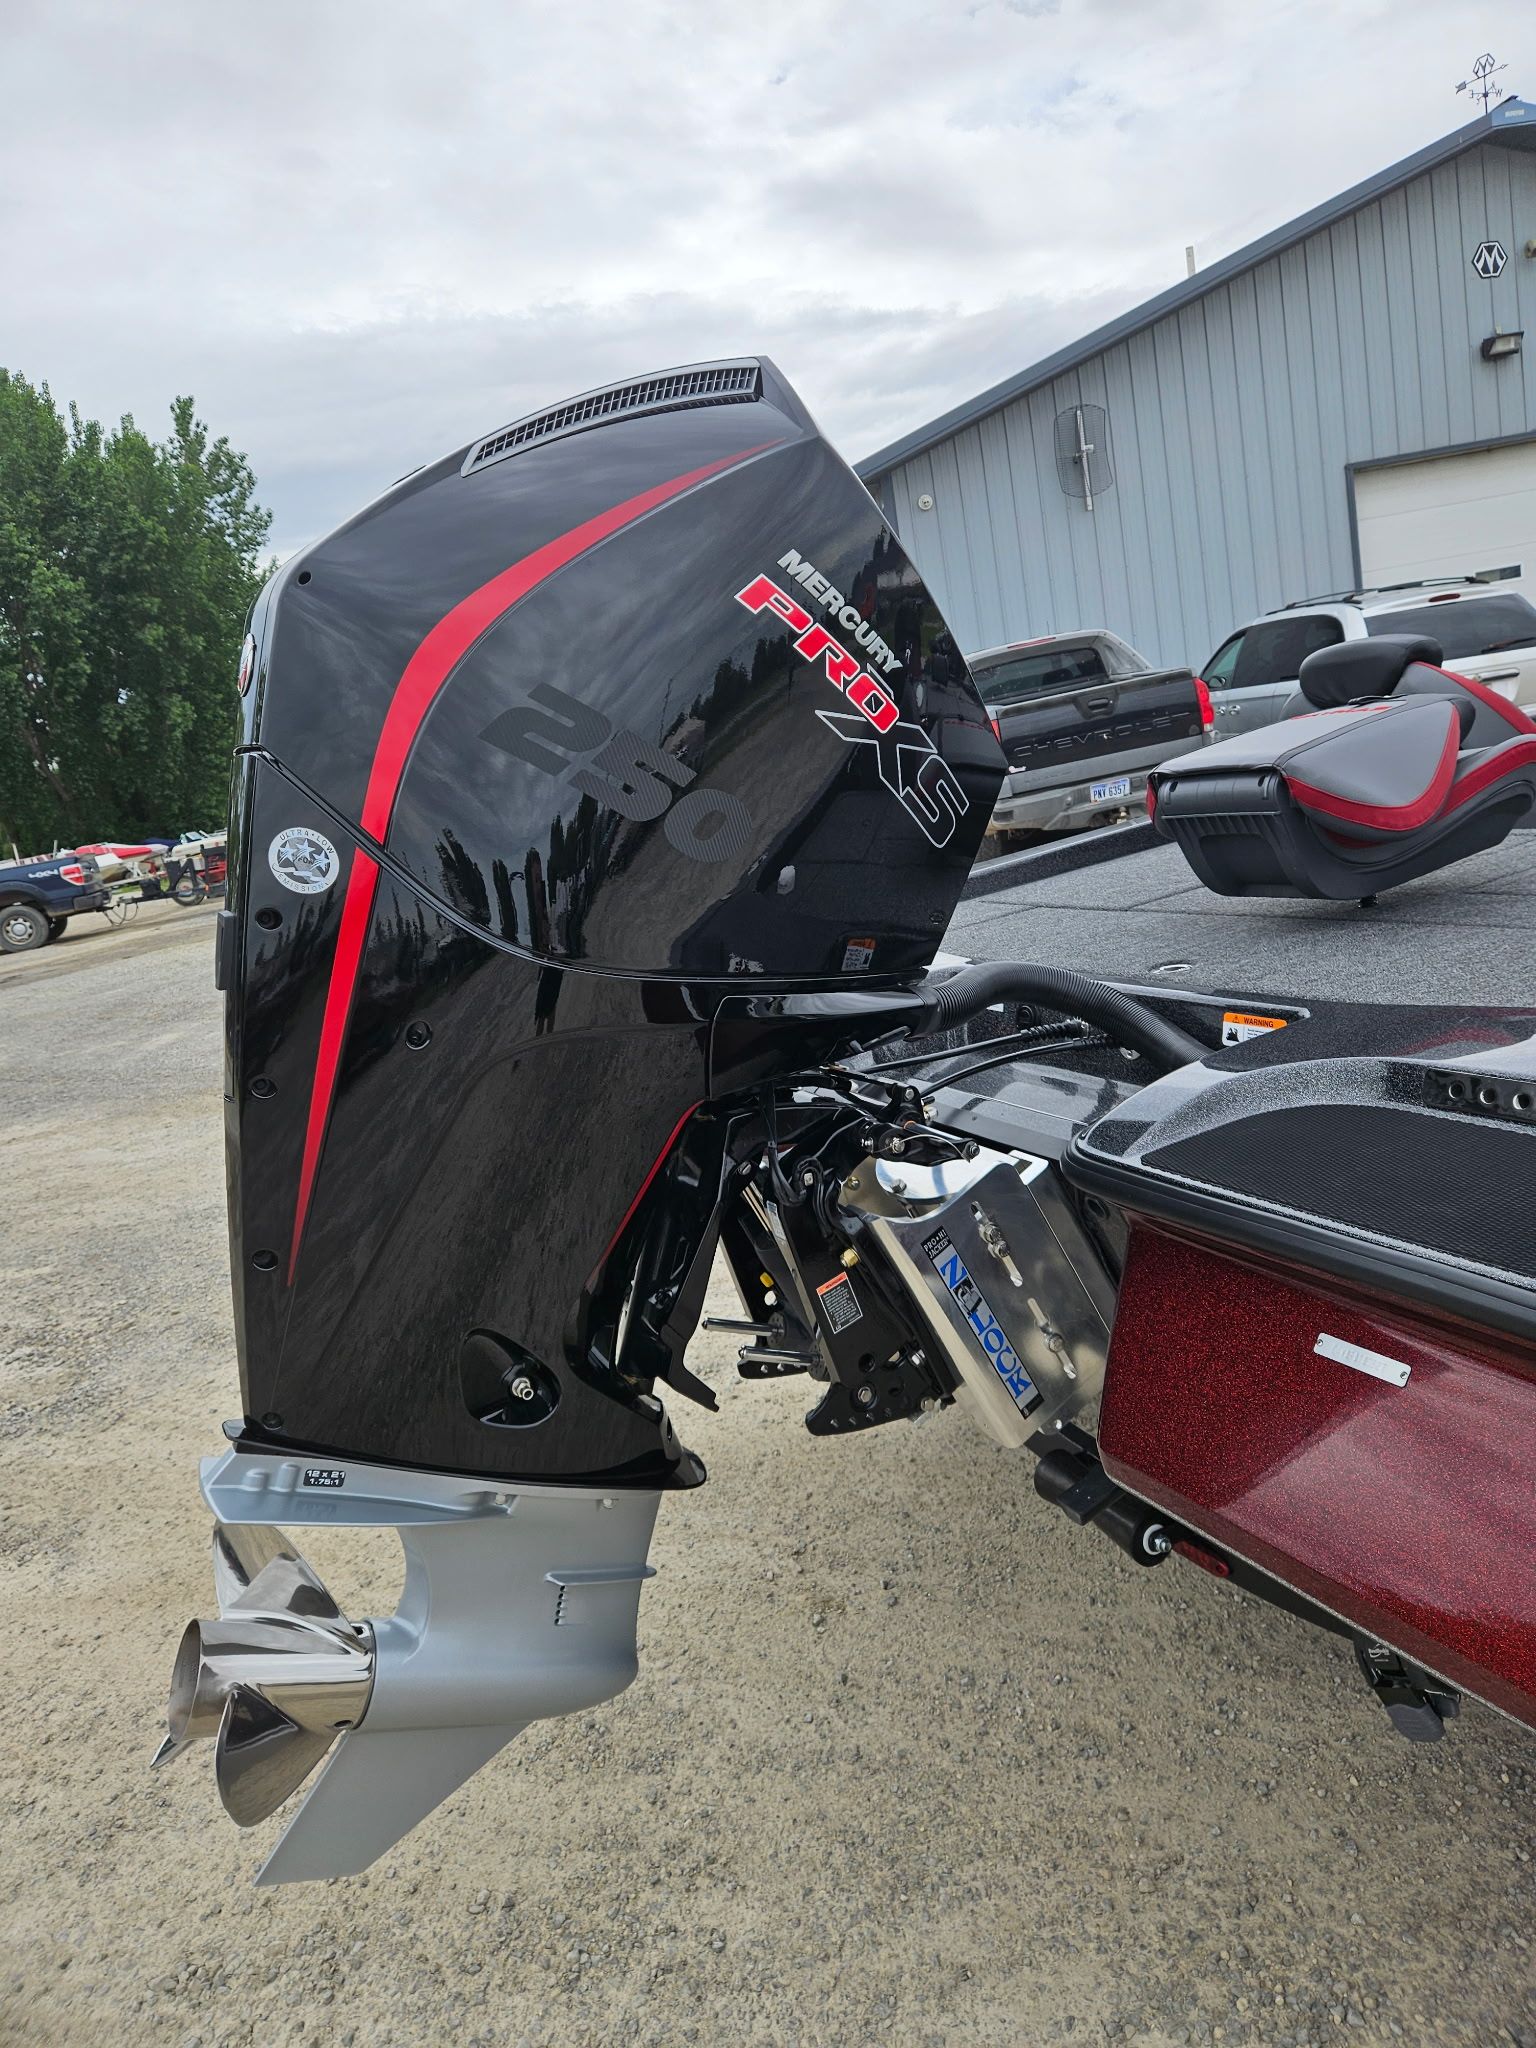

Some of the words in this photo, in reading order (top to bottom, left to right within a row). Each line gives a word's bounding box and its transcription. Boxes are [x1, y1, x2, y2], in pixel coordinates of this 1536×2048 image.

[776, 548, 903, 674] MERCURY
[733, 572, 900, 734] PRO
[476, 682, 752, 864] 250
[814, 662, 970, 848] XS
[316, 836, 334, 854] LOW
[1243, 1016, 1274, 1028] WARNING
[306, 1470, 320, 1478] 12
[330, 1471, 346, 1479] 21
[309, 1478, 340, 1486] 1.75:1
